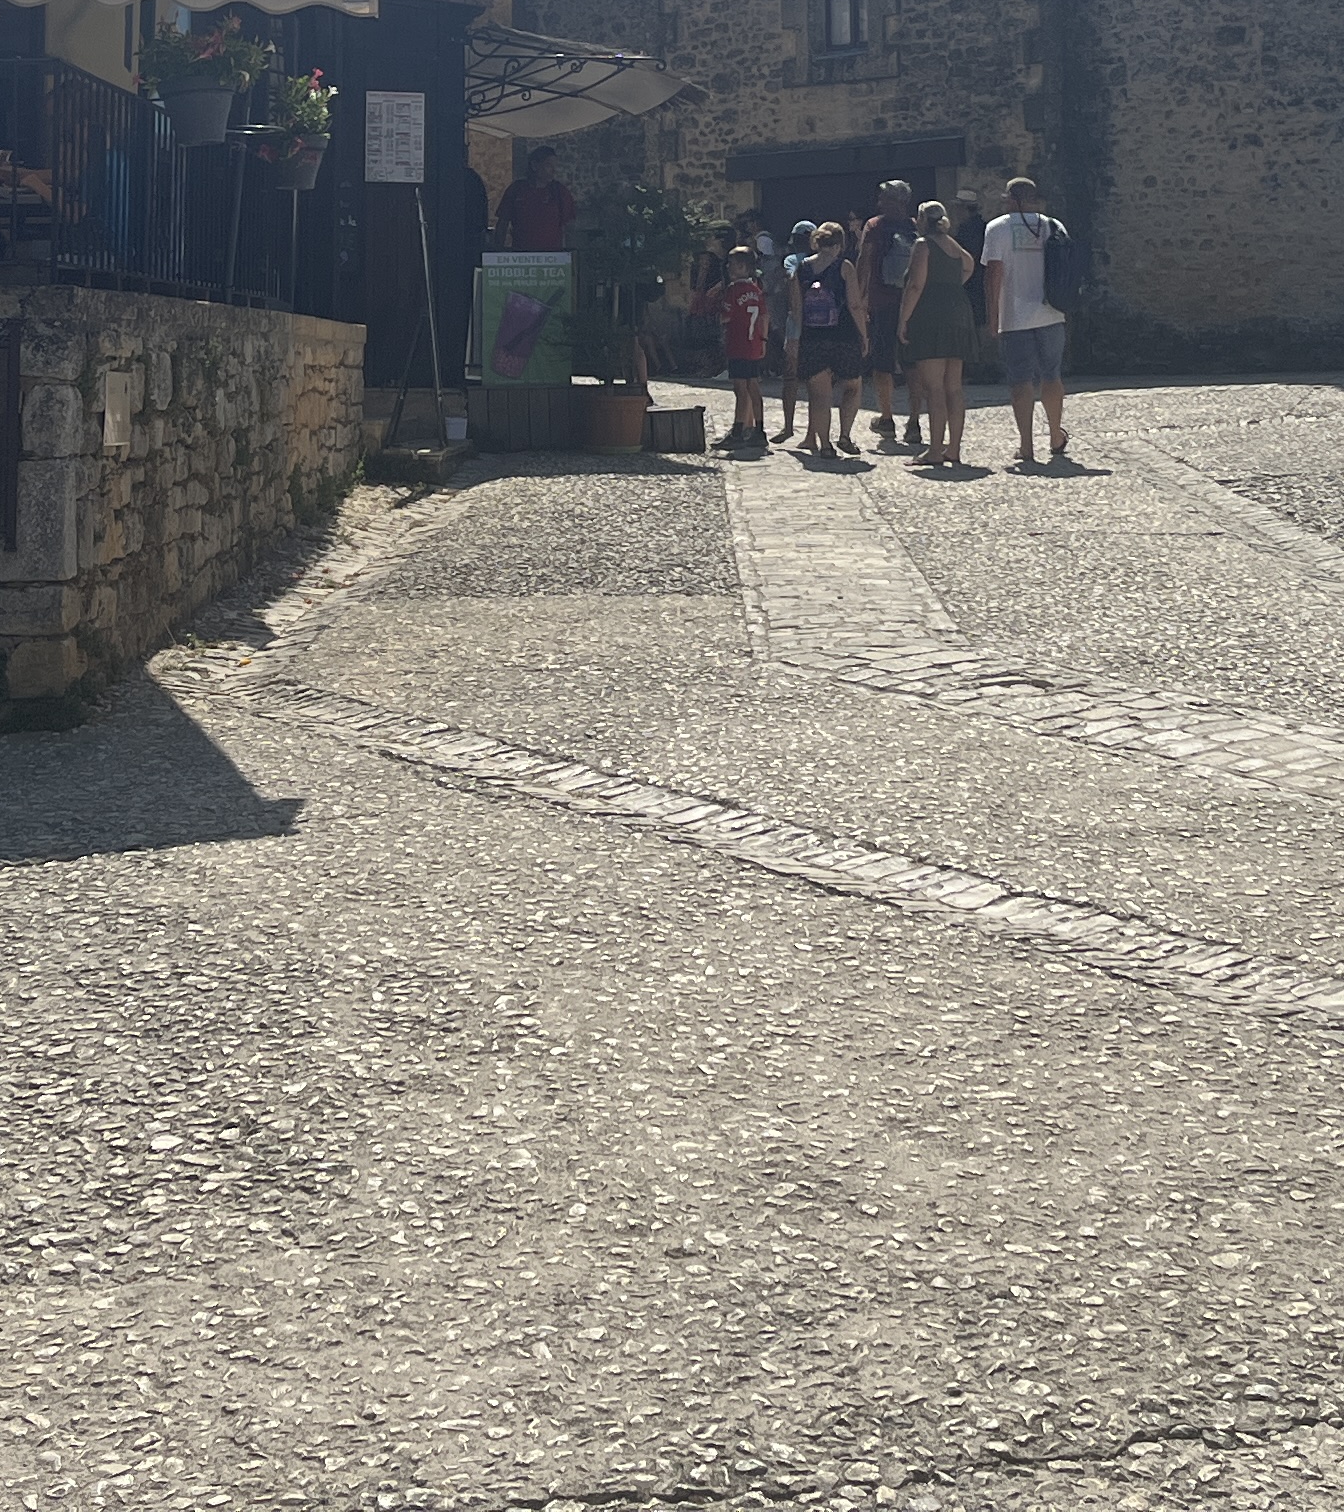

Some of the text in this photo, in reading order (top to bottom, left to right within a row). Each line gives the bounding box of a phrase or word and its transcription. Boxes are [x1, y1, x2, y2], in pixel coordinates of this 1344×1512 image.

[488, 268, 565, 277] BUBBLE TEA
[747, 306, 759, 340] 7
